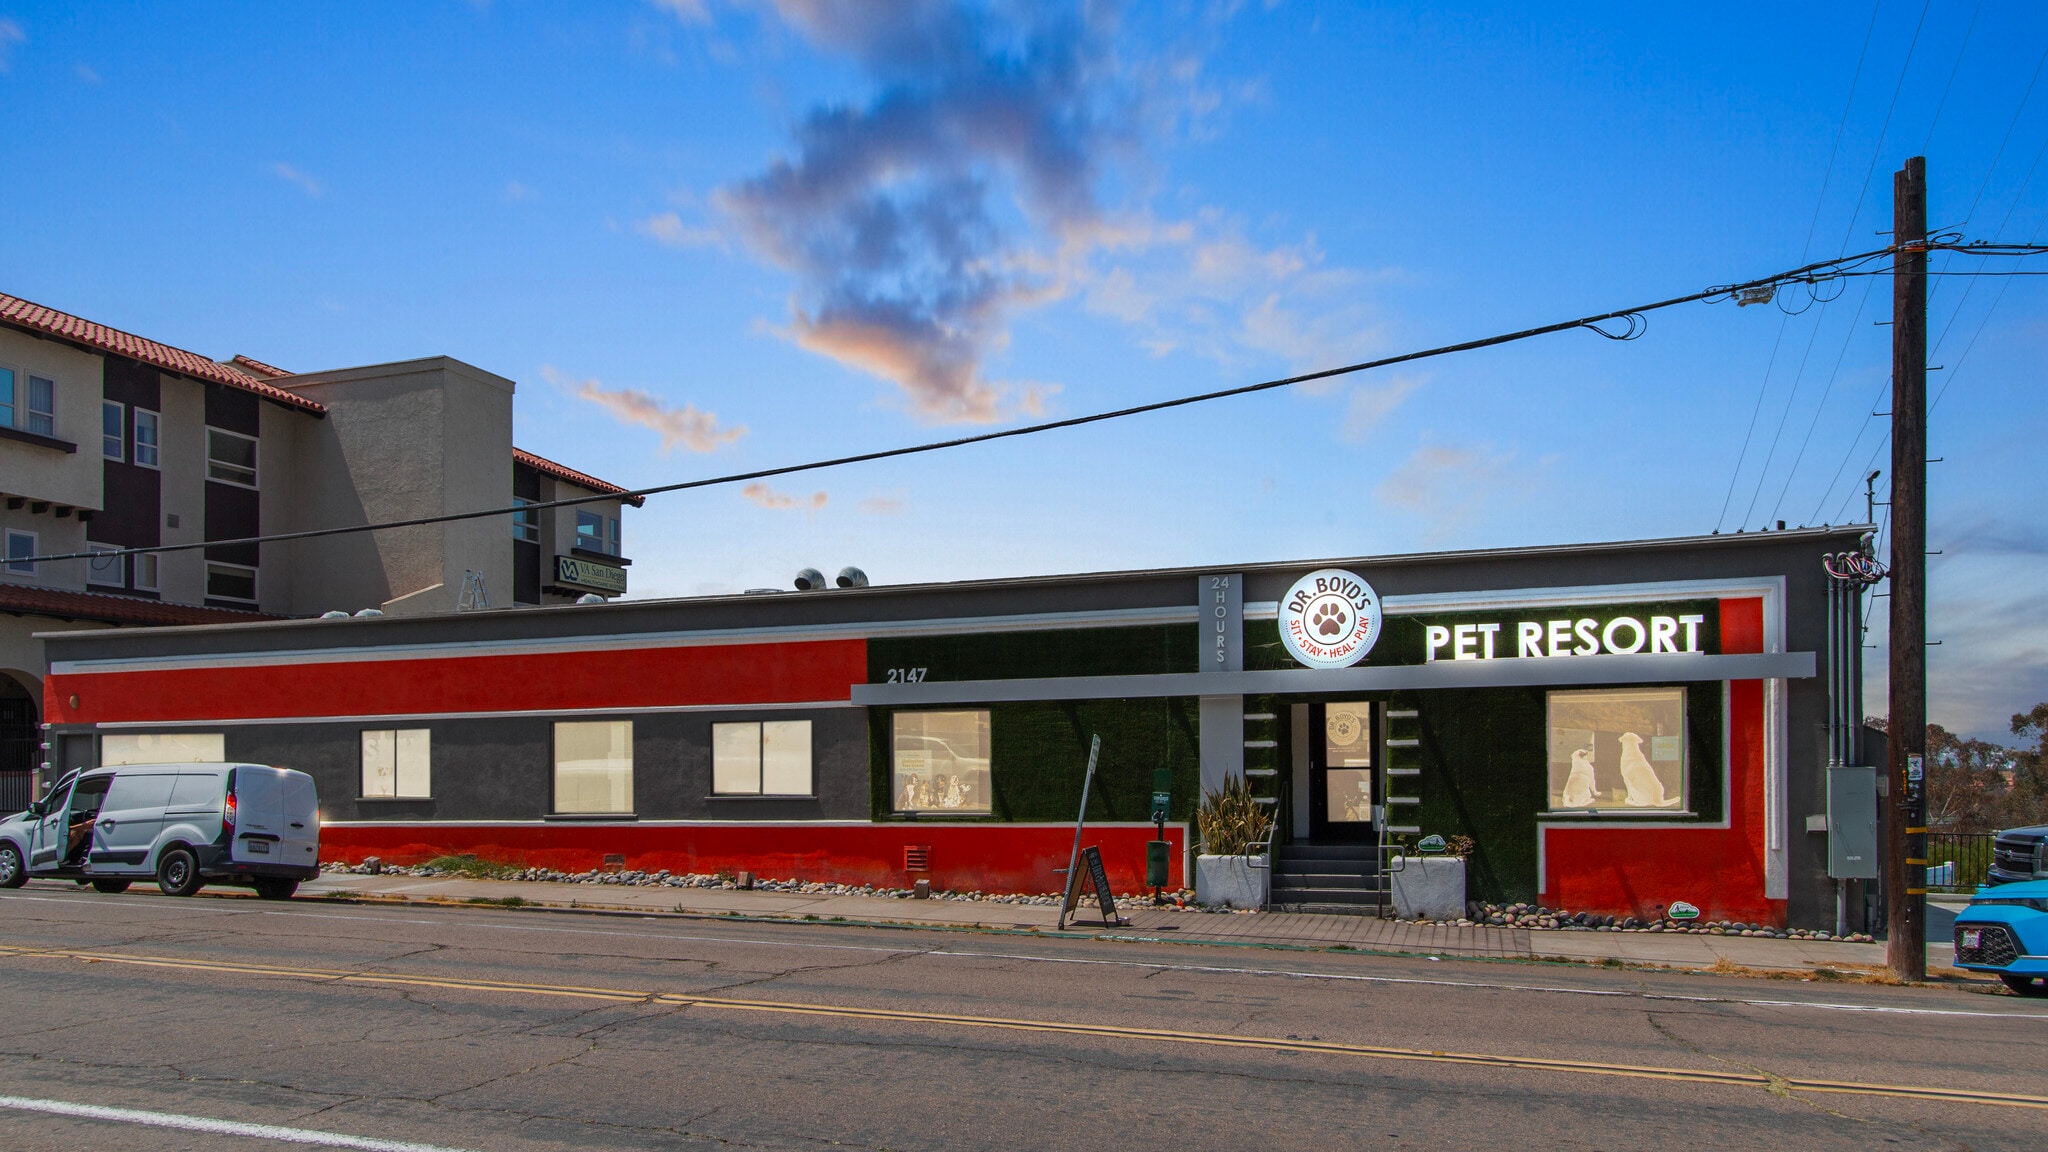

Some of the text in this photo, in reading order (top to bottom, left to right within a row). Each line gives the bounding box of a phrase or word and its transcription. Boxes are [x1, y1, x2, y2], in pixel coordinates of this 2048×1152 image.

[580, 562, 625, 583] VA San Diego
[1211, 576, 1230, 590] 24
[1214, 591, 1227, 663] HOURS
[1290, 615, 1370, 659] SIT STAY HEAL PLAY
[1426, 614, 1704, 661] PET RESORT
[887, 667, 928, 684] 2147
